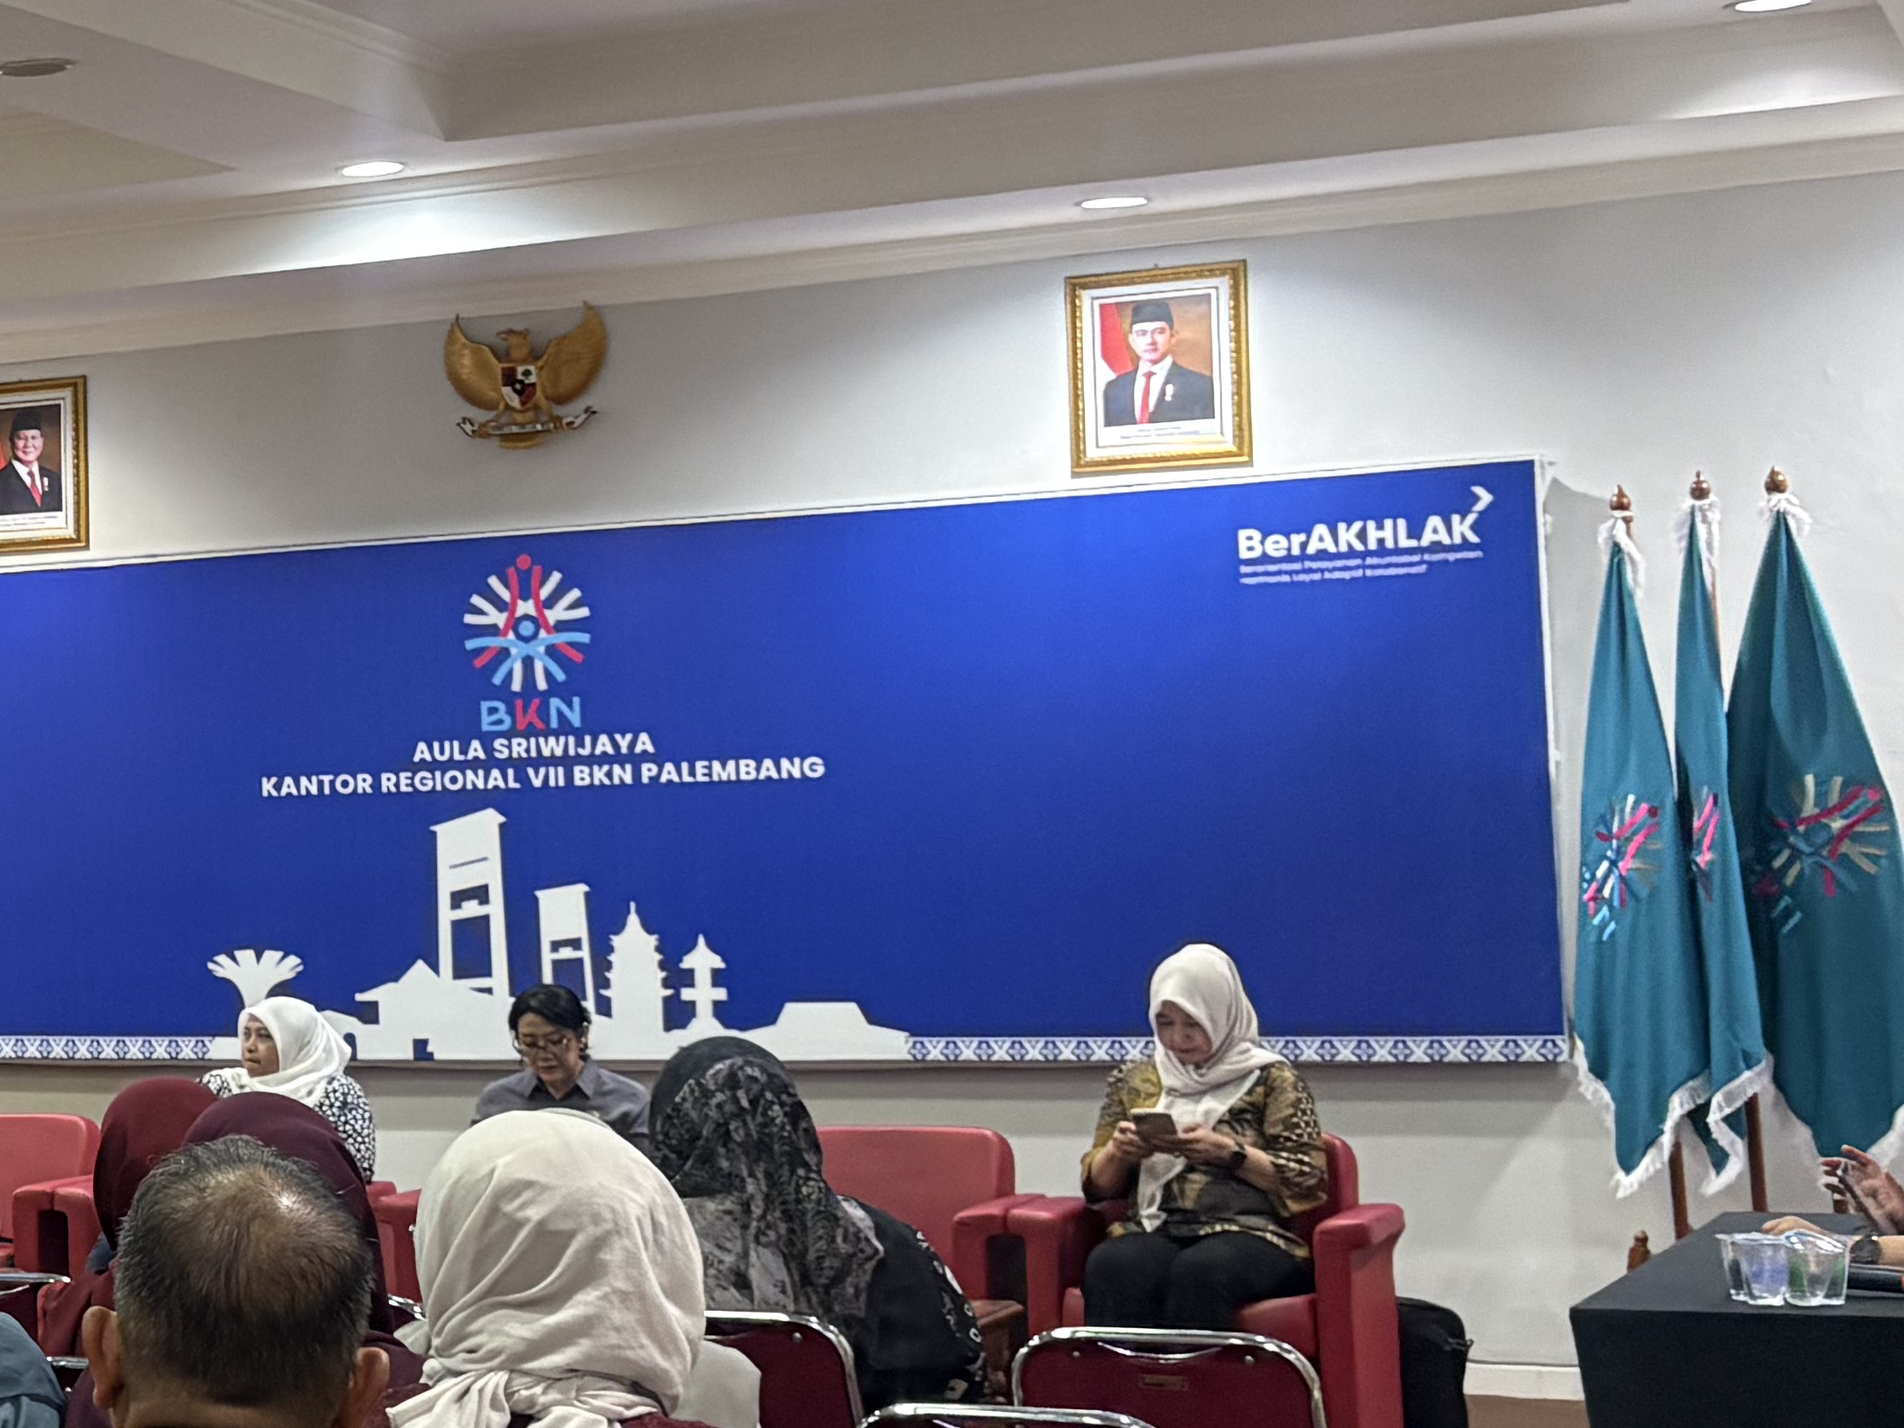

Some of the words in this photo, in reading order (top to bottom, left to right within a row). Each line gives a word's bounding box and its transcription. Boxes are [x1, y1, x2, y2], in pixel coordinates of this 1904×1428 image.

[1237, 512, 1481, 559] BerAKHLAK
[479, 696, 581, 732] BKN
[413, 739, 487, 763] AULA
[493, 731, 655, 759] SRIWIJAYA
[261, 773, 373, 797] KANTOR
[380, 767, 521, 793] REGIONAL
[526, 765, 565, 788] VII
[573, 763, 633, 787] BKN
[640, 756, 825, 784] PALEMBANG
